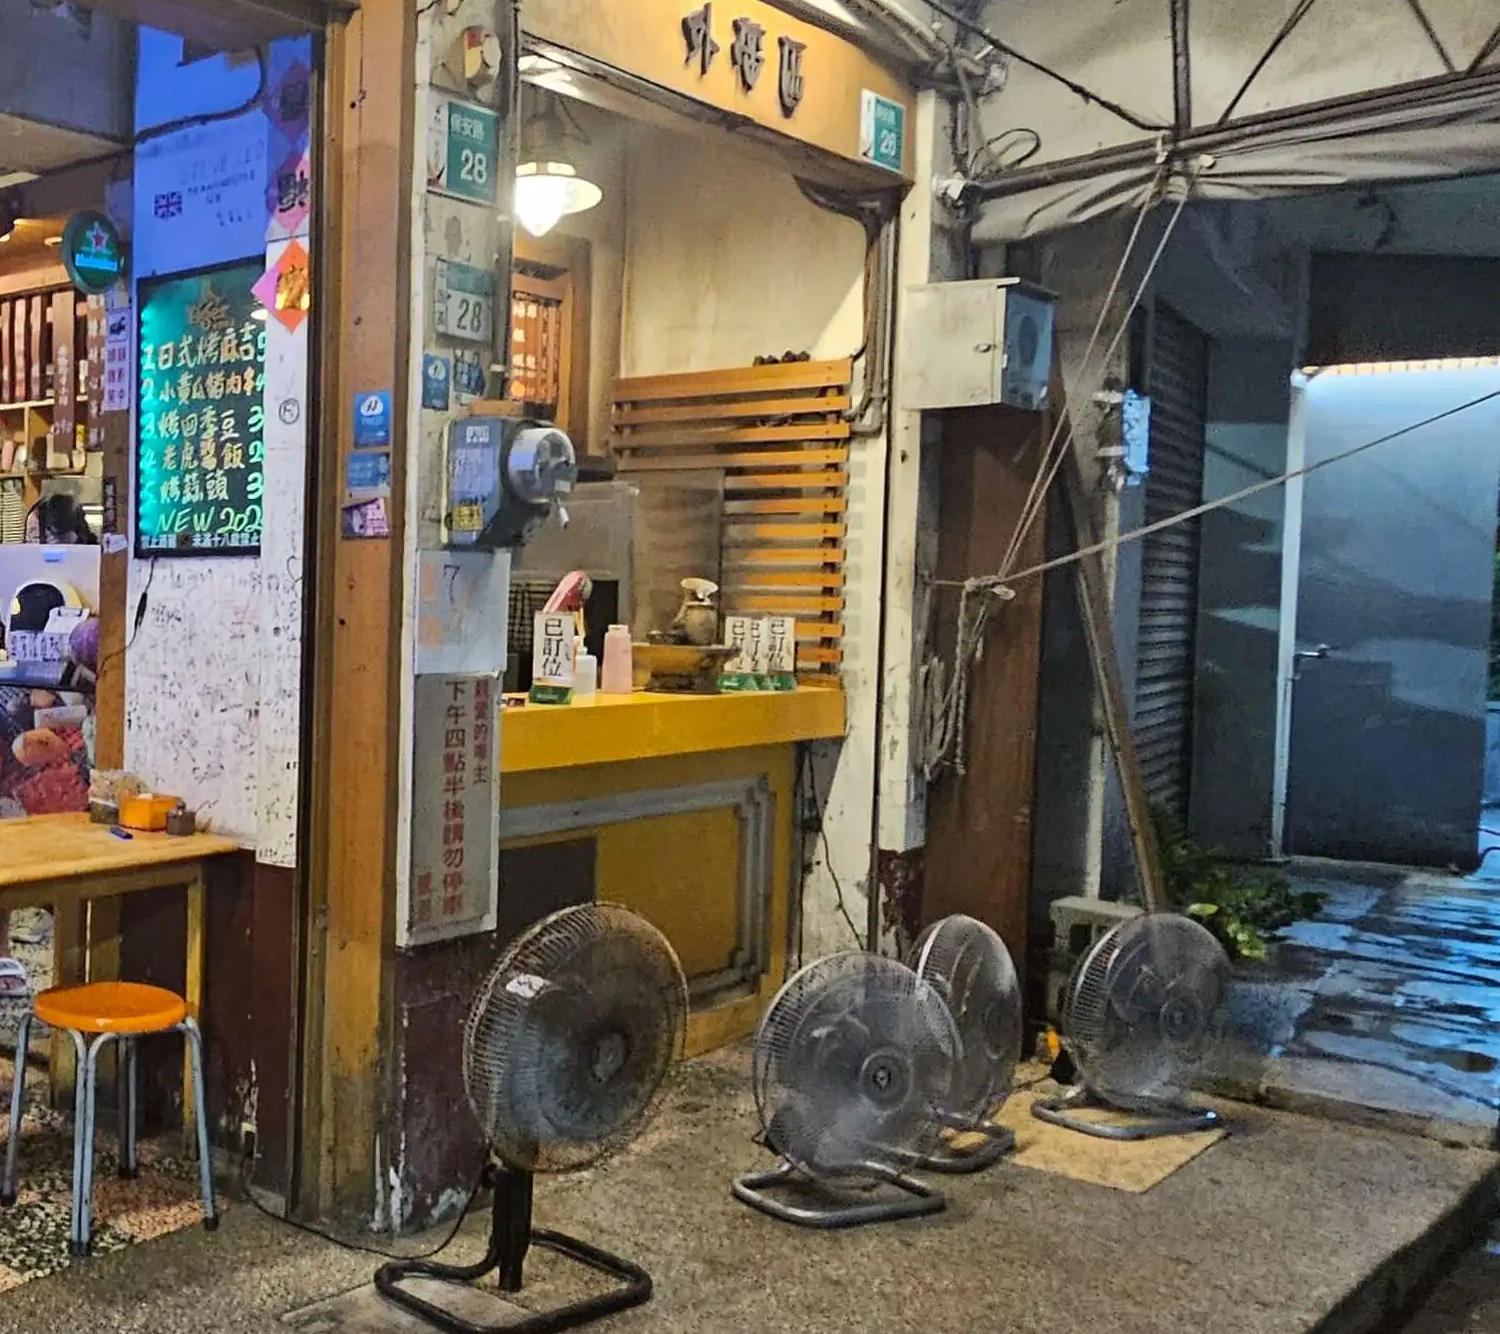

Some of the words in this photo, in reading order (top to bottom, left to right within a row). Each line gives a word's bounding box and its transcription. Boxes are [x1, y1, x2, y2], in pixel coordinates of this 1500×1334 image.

[459, 148, 488, 185] 28
[456, 297, 483, 334] 28
[155, 506, 215, 535] NEW
[543, 618, 564, 677] 已訂位
